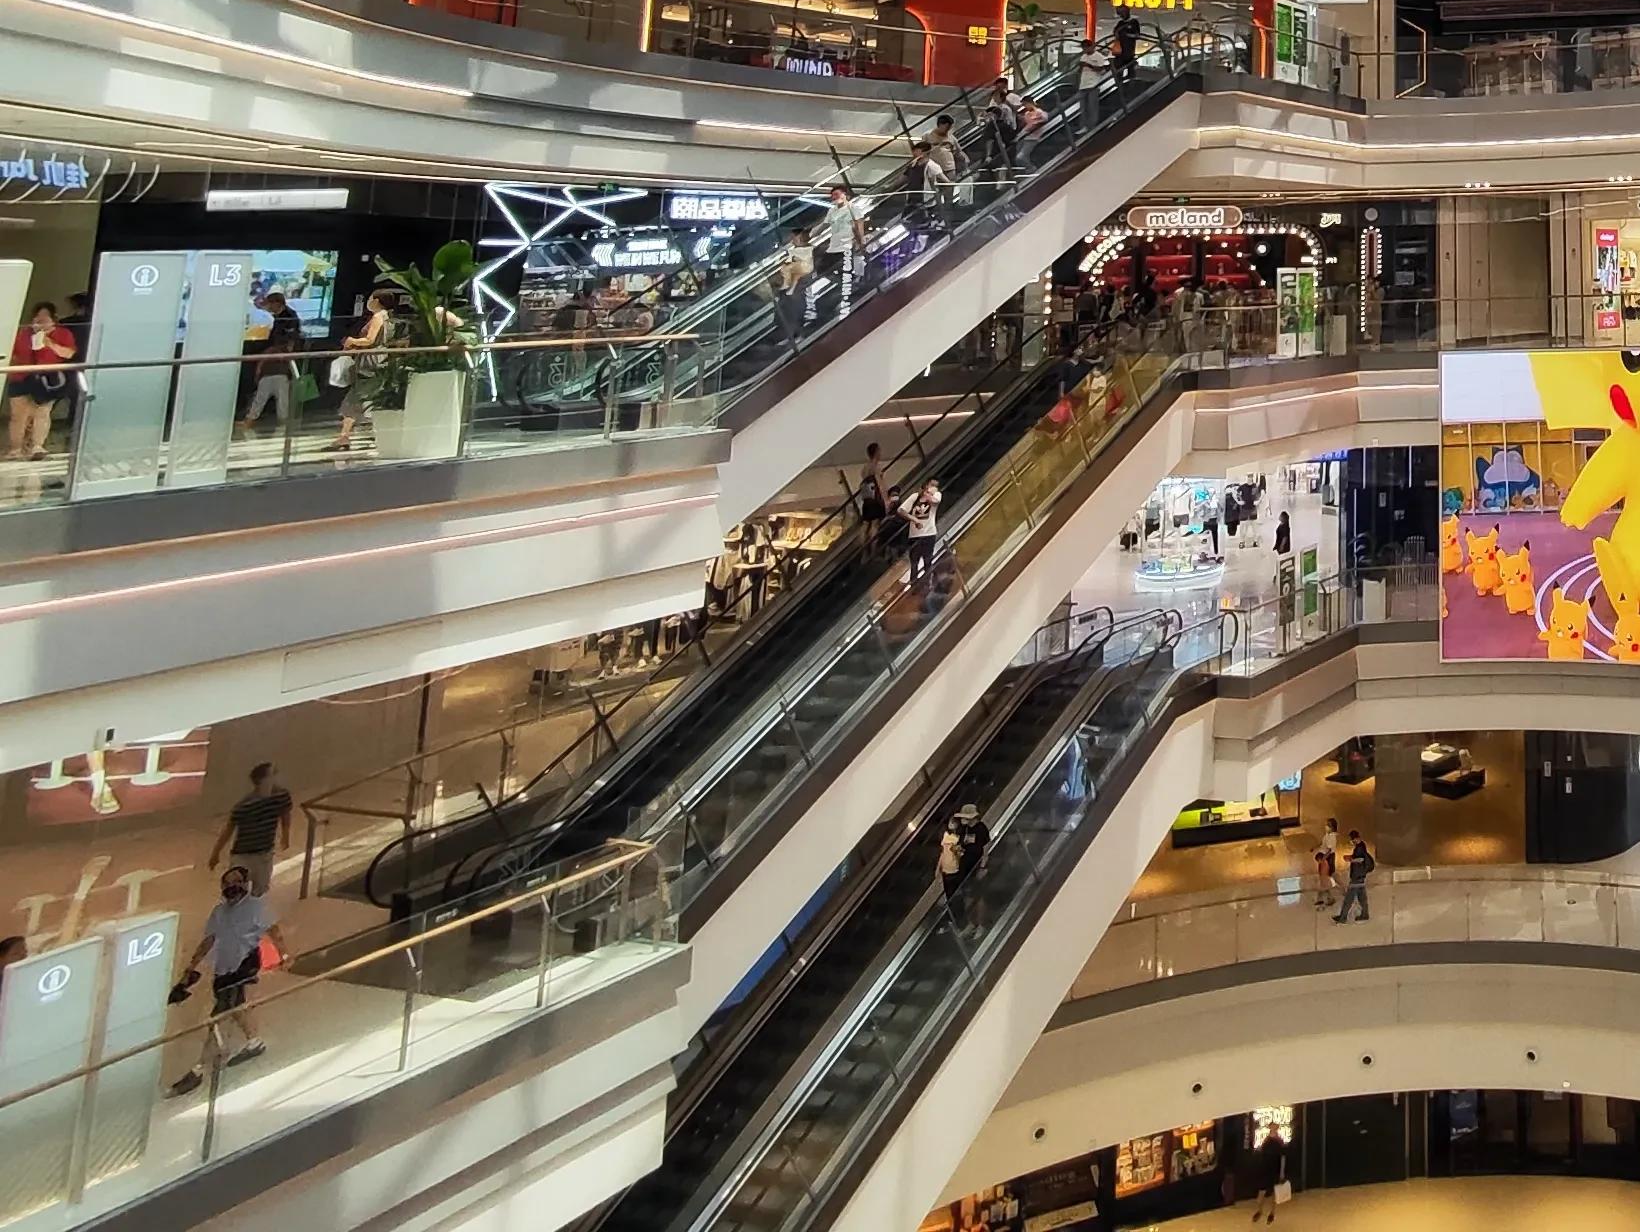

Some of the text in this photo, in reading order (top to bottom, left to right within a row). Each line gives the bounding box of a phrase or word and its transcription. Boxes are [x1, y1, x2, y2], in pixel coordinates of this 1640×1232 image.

[1145, 207, 1225, 228] meland
[209, 263, 243, 287] L3
[126, 931, 166, 966] L2
